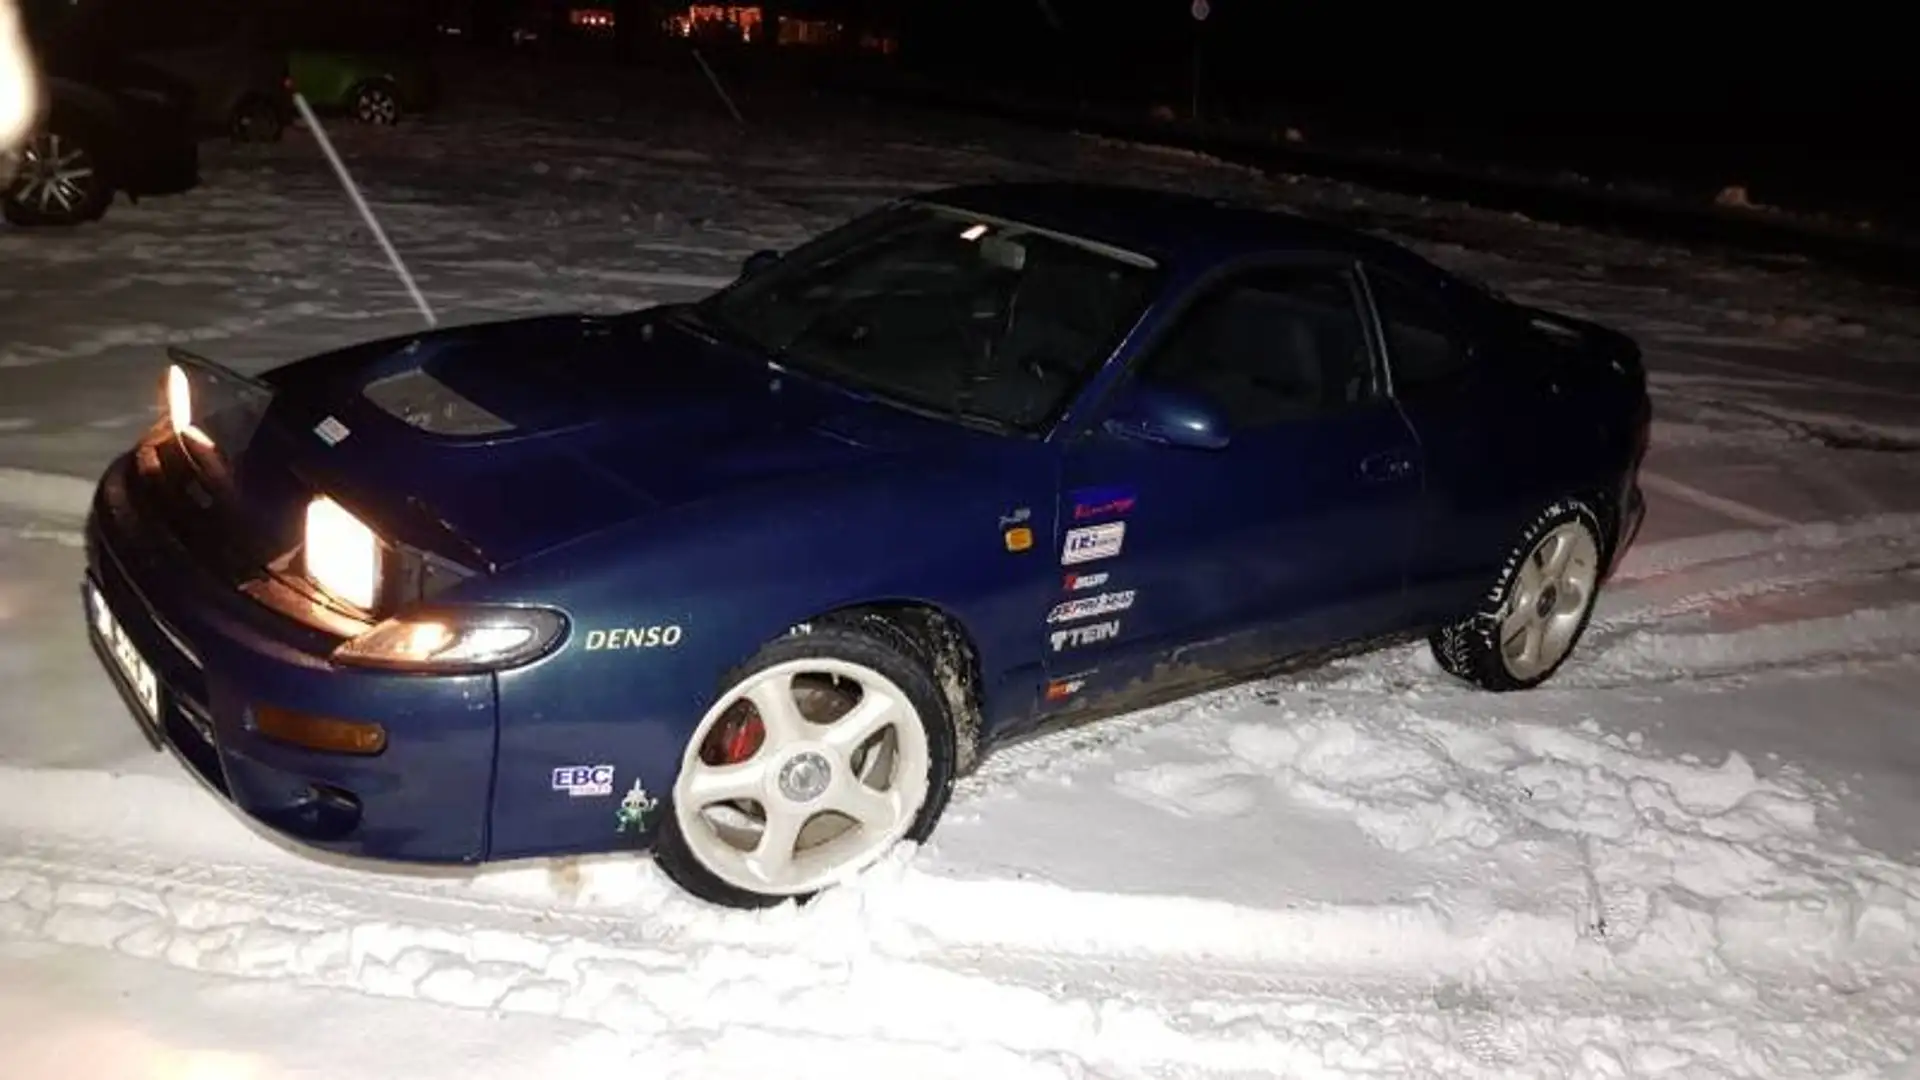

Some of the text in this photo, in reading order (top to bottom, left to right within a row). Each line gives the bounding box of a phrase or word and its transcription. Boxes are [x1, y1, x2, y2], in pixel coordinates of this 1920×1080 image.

[585, 625, 682, 650] DENSO
[1067, 620, 1120, 647] TEIN
[556, 768, 609, 786] EBC
